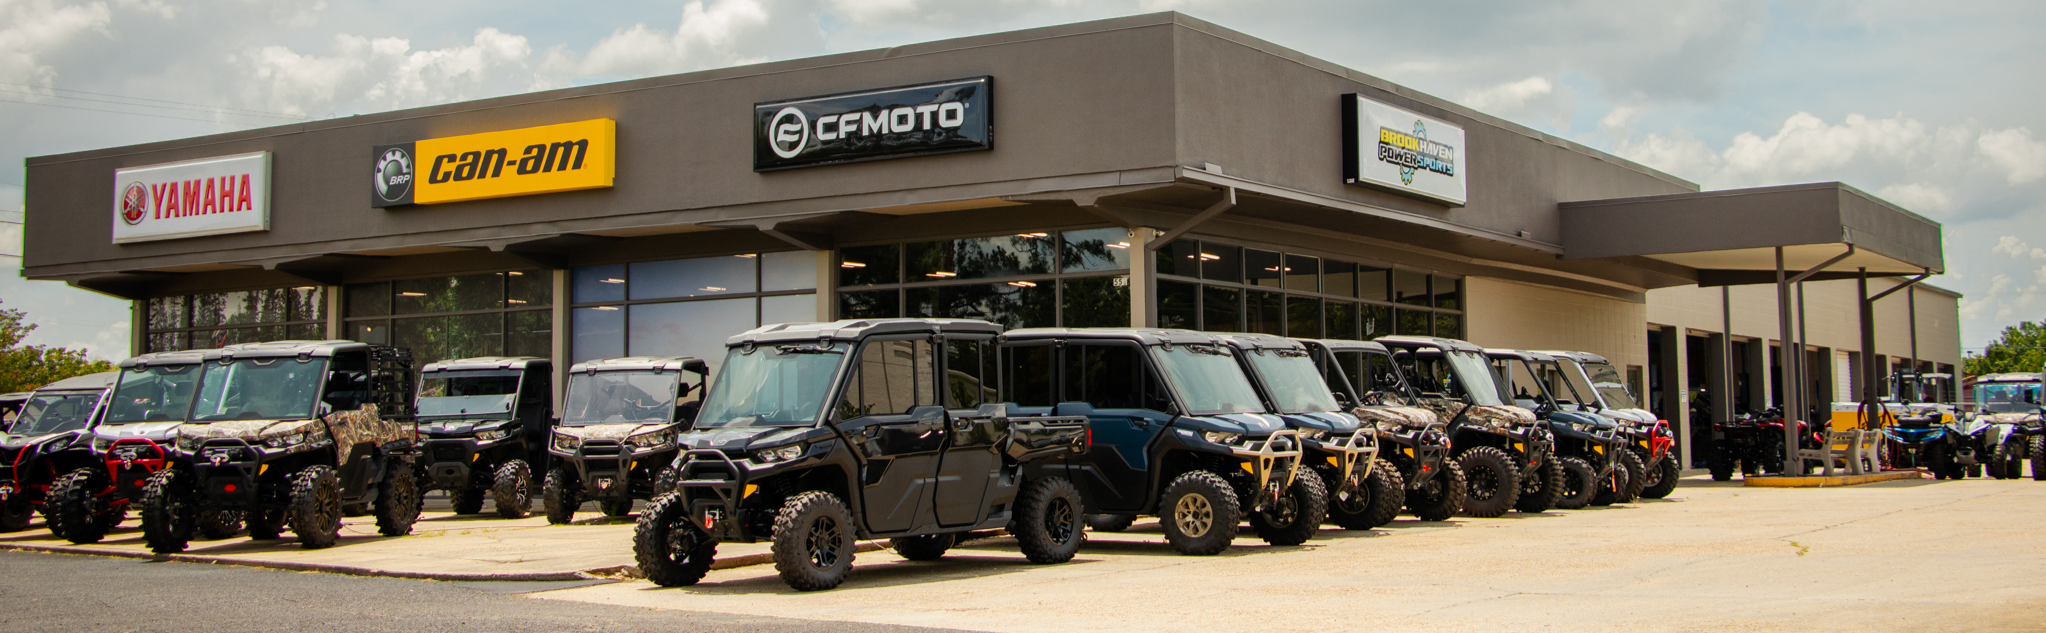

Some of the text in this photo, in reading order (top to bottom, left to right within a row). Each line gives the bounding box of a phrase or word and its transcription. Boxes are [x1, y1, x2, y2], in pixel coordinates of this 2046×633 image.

[816, 101, 965, 141] CFMOTO
[428, 138, 589, 185] can-am
[1378, 143, 1454, 177] POWERSPORTS
[1379, 127, 1454, 162] BROOKHAVEN
[151, 173, 252, 220] YAMAHA
[389, 174, 411, 185] BRP
